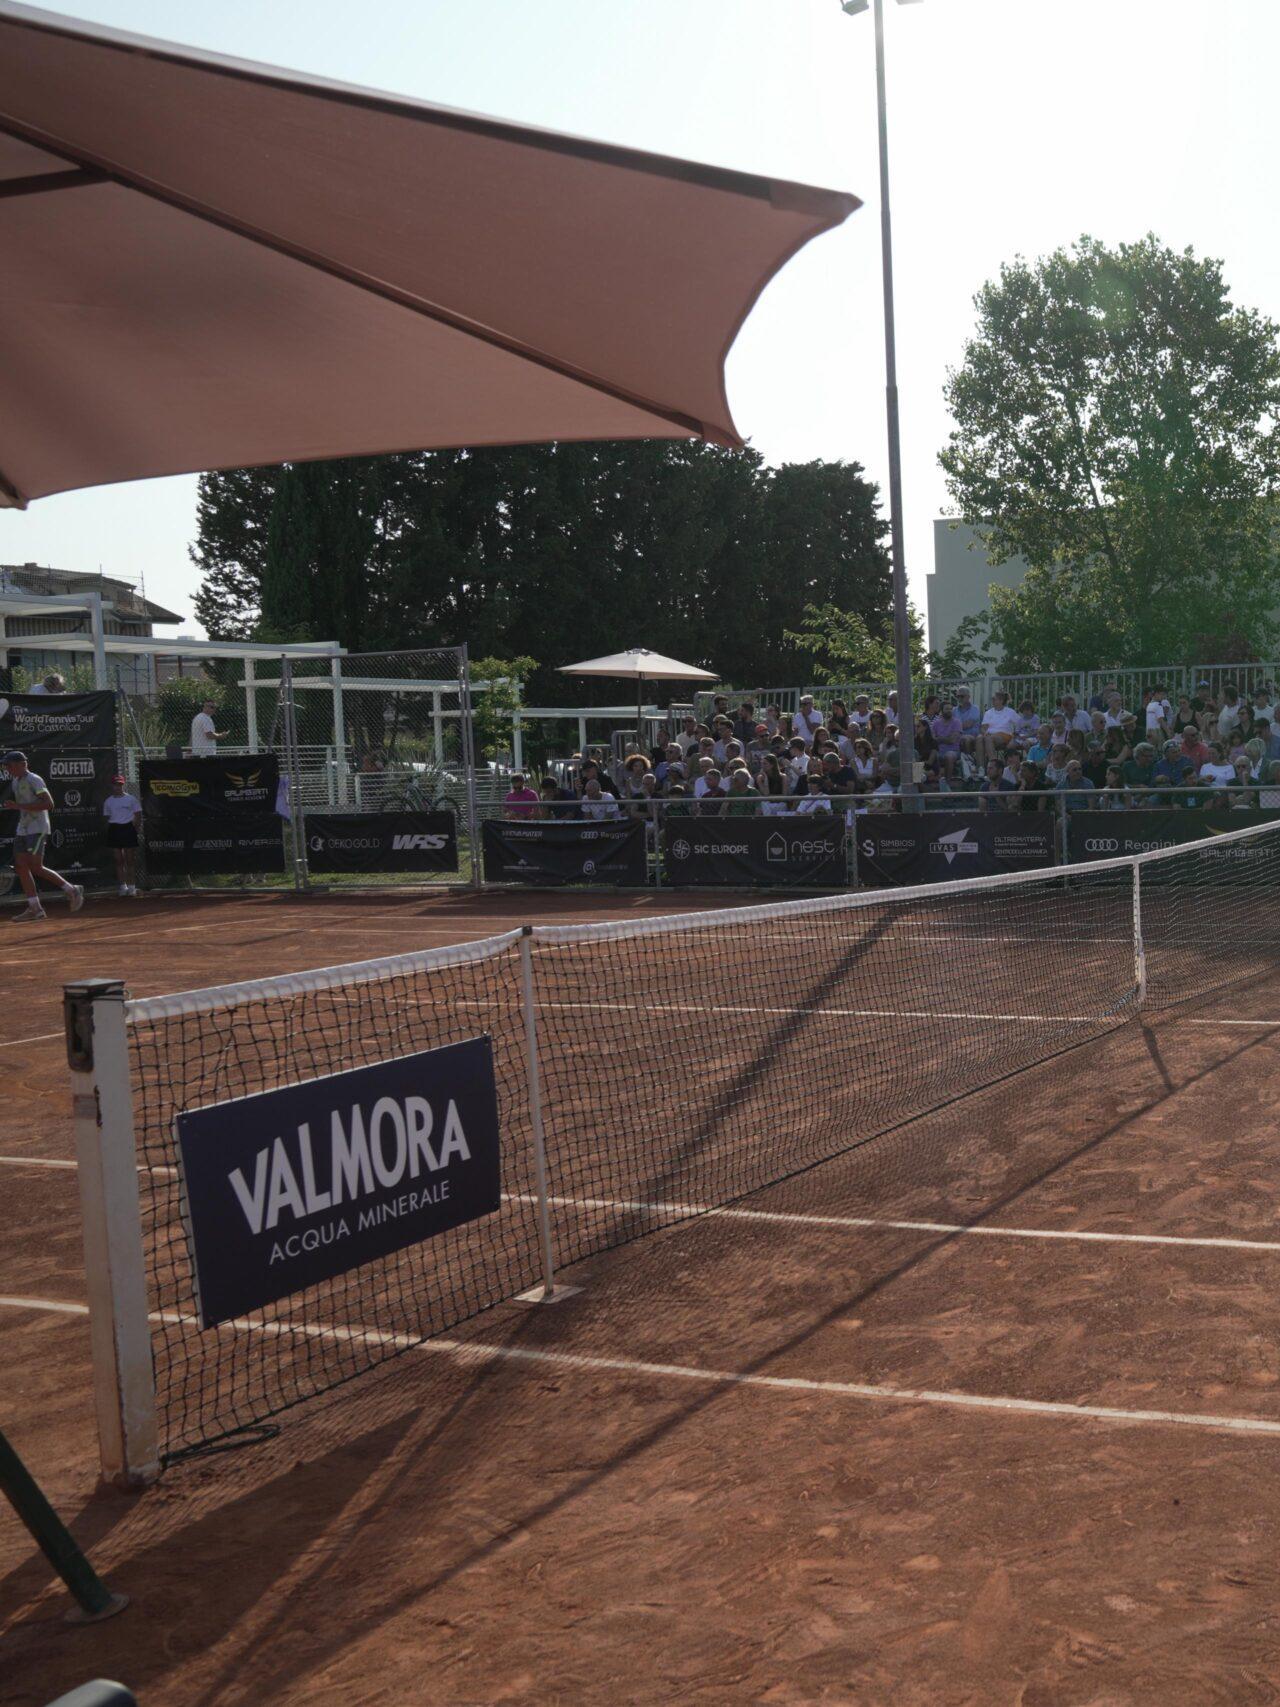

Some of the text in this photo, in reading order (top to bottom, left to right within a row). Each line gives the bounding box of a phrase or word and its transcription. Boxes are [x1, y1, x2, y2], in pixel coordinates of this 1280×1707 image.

[50, 761, 95, 776] GOLFETTA
[693, 844, 749, 855] SIC EUROPE
[791, 839, 835, 853] nest
[932, 843, 955, 852] IVAS
[227, 1096, 471, 1235] VALMORA
[268, 1179, 450, 1265] ACQUA MINERALE
